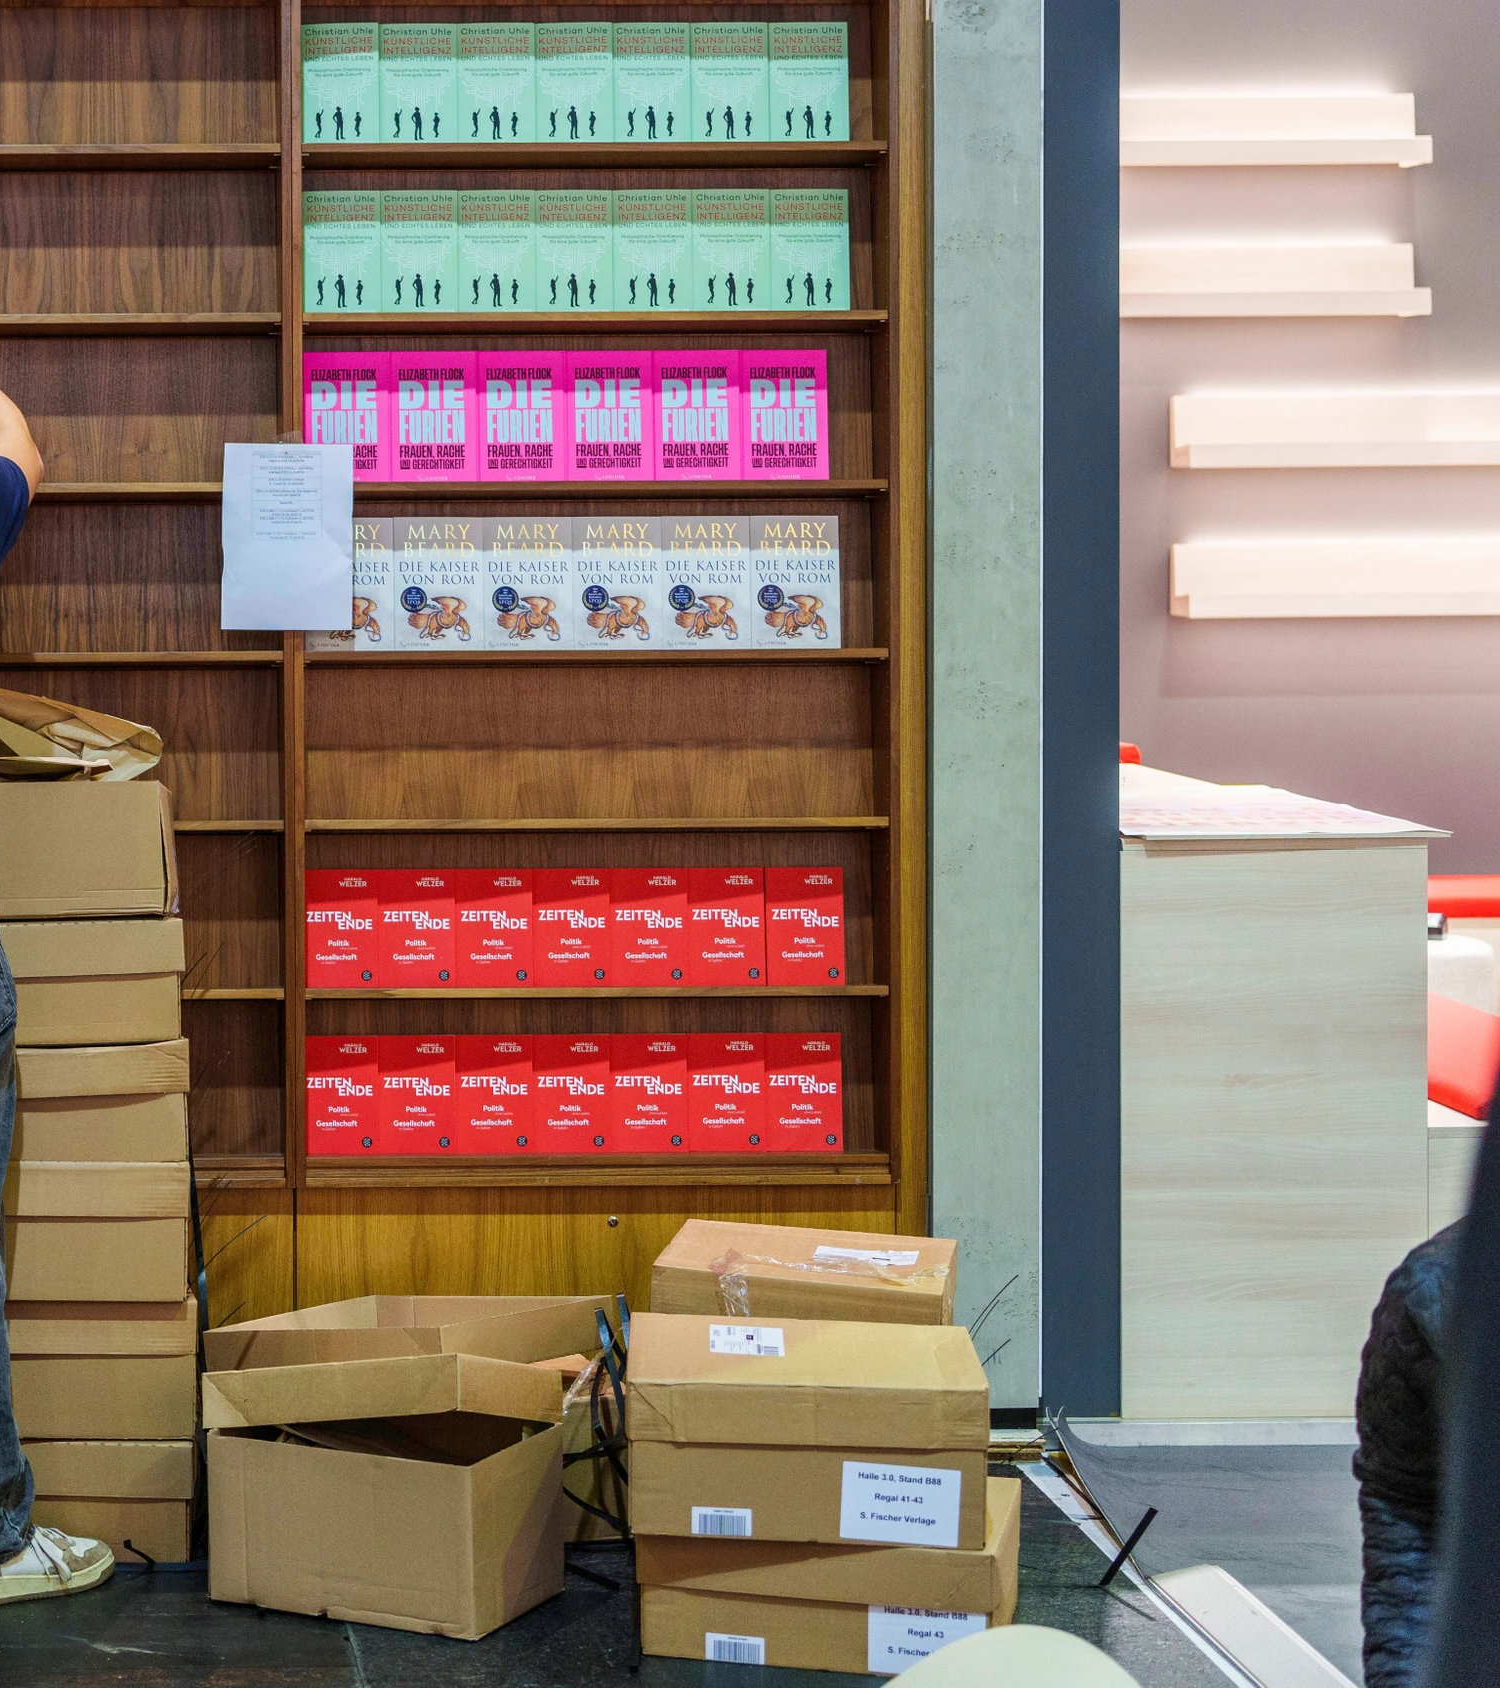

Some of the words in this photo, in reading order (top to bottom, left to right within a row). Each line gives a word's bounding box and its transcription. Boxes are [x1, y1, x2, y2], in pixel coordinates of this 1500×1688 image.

[305, 28, 348, 36] Christian
[305, 37, 373, 45] KÜNSTLICHE
[305, 46, 373, 55] INTELLIGENZ
[775, 202, 843, 210] KÜNSTLICHE
[399, 369, 438, 380] ELIZABETH
[440, 368, 464, 380] FLOCK
[575, 368, 615, 379] ELIZABETH
[617, 367, 640, 378] FLOCK
[750, 367, 790, 378] ELIZABETH
[792, 367, 815, 378] FLOCK
[399, 381, 464, 409] DIE
[575, 379, 640, 408] DIE
[750, 379, 815, 407] DIE
[399, 410, 465, 444] FURIEN
[576, 408, 641, 442] FURIEN
[751, 408, 816, 442] FURIEN
[400, 445, 435, 458] FRAUEN,
[437, 445, 465, 457] RACHE
[576, 444, 611, 456] FRAUEN,
[613, 443, 641, 456] RACHE
[751, 443, 786, 456] FRAUEN,
[788, 443, 816, 456] RACHE
[400, 459, 410, 469] UND
[413, 459, 465, 469] GERECHTIGKEIT
[576, 458, 587, 468] UND
[589, 457, 641, 468] GERECHTIGKEIT
[751, 457, 762, 468] UND
[764, 457, 816, 467] GERECHTIGKEIT
[408, 524, 470, 539] MARY
[586, 523, 649, 539] MARY
[764, 522, 826, 538] MARY
[404, 542, 475, 558] BEARD
[582, 541, 653, 557] BEARD
[760, 541, 831, 556] BEARD
[400, 562, 423, 572] DIE
[430, 562, 480, 572] KAISER
[578, 561, 601, 571] DIE
[609, 561, 658, 571] KAISER
[756, 560, 779, 571] DIE
[787, 560, 836, 570] KAISER
[402, 574, 434, 584] VON
[442, 574, 475, 584] ROM
[581, 574, 613, 584] VON
[621, 574, 653, 584] ROM
[759, 573, 791, 583] VON
[798, 573, 831, 583] ROM
[306, 911, 352, 922] ZEITEN
[616, 910, 661, 920] ZEITEN
[338, 919, 373, 929] ENDE
[647, 918, 682, 928] ENDE
[770, 1075, 815, 1086] ZEITEN
[801, 1083, 836, 1093] ENDE
[858, 1472, 879, 1480] Halle
[882, 1474, 896, 1482] 3.0,
[899, 1475, 922, 1483] Stand
[875, 1493, 898, 1502] Regal
[901, 1496, 923, 1504] 41-43
[871, 1513, 902, 1522] Fischer
[904, 1516, 936, 1526] Verlage
[884, 1606, 905, 1615] Halle
[908, 1609, 922, 1617] 3.0,
[925, 1610, 948, 1619] Stand
[908, 1628, 931, 1638] Regal
[888, 1646, 896, 1654] S.
[898, 1647, 930, 1656] Fischer
